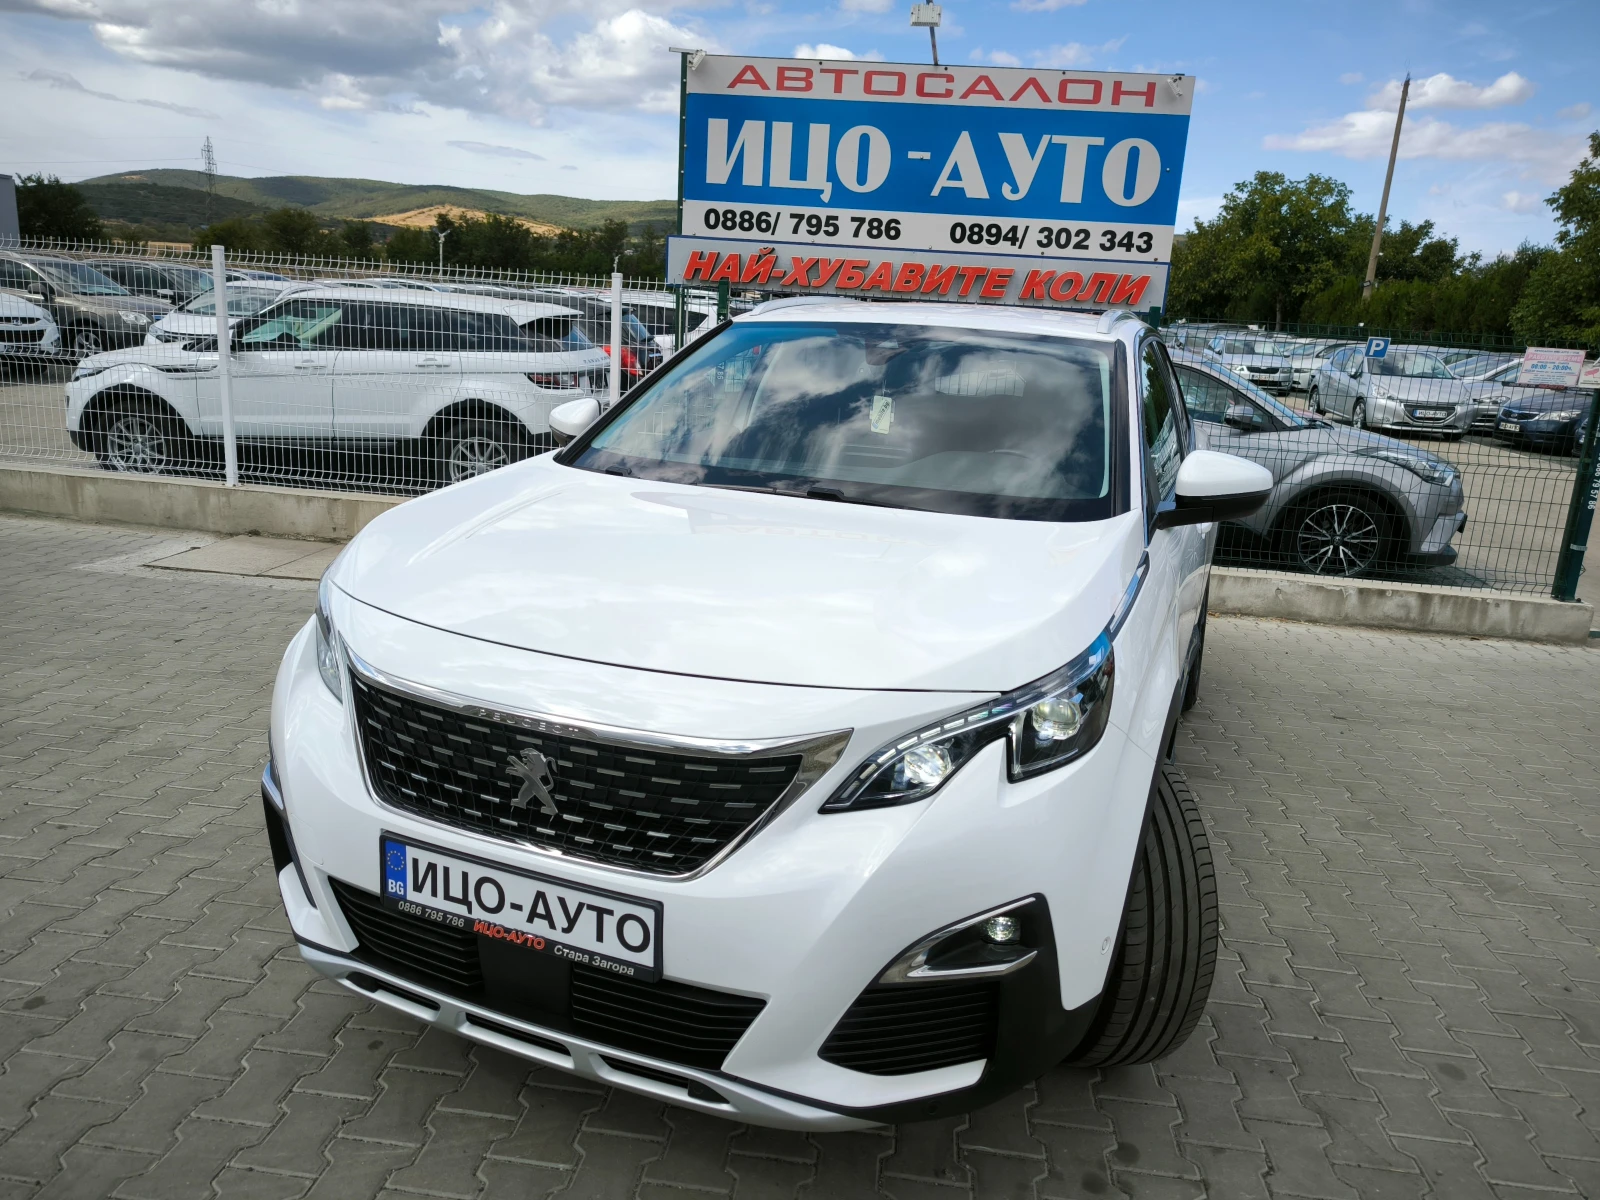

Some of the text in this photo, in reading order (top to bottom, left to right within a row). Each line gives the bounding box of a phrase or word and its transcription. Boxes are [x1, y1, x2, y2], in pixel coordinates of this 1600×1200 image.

[727, 64, 1157, 108] АВТОСАЛОН
[789, 212, 840, 237] 795
[850, 216, 902, 241] 786
[1036, 226, 1091, 251] 302
[1099, 229, 1154, 254] 343
[682, 246, 1152, 306] НАЙ-ХУБАВИТЕ КОЛИ
[1370, 339, 1385, 356] P
[1587, 500, 1596, 510] 86
[1590, 489, 1599, 499] 57
[388, 879, 404, 896] BG
[411, 856, 651, 954] ИЦО-АУТО
[398, 901, 635, 976] 0886 795 786 ИЦО-АУТО Стара Загора
